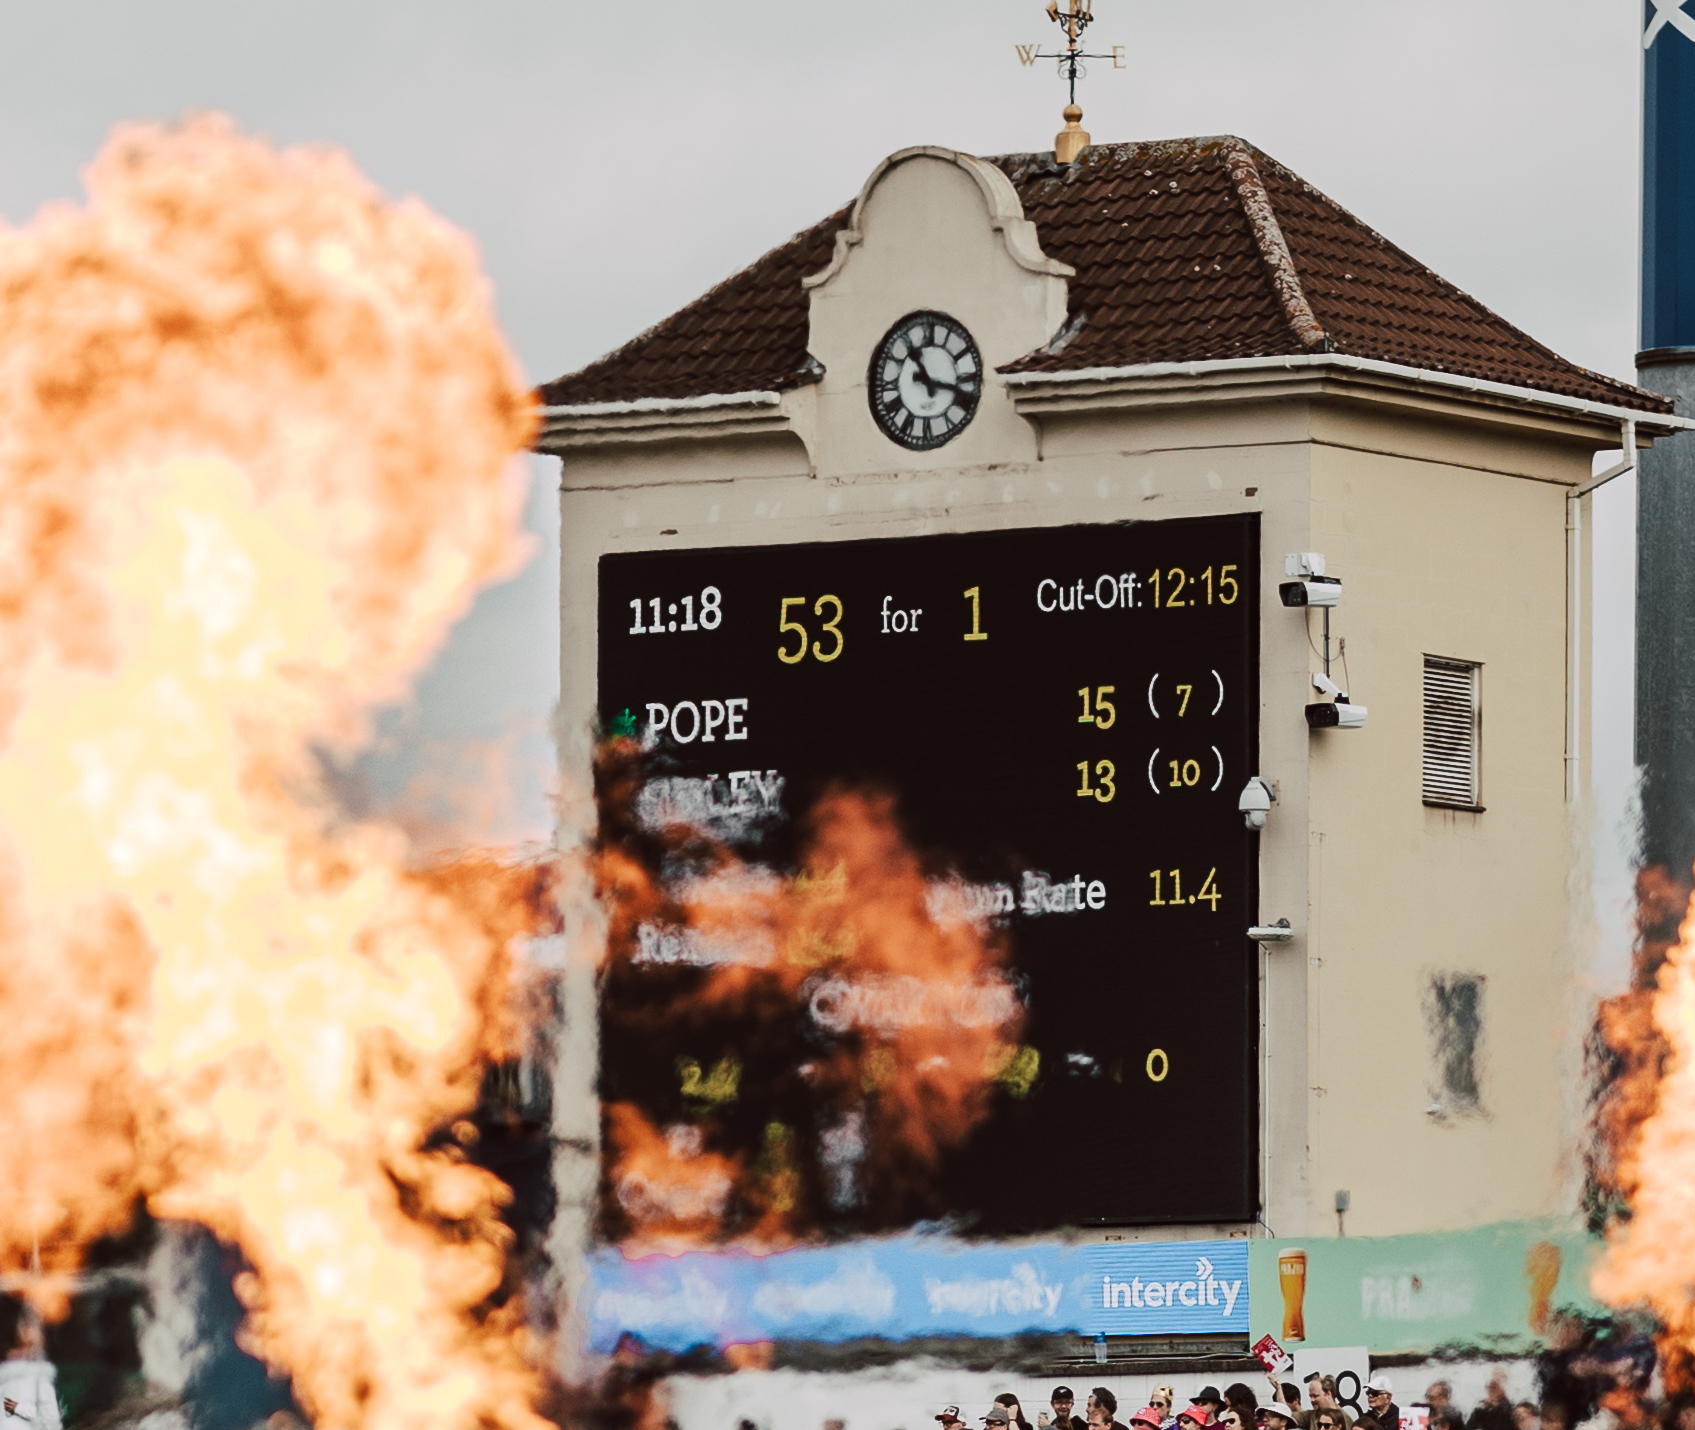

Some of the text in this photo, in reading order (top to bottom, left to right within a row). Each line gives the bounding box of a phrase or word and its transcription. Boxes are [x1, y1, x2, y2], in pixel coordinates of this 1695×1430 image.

[1037, 565, 1238, 612] Cut-Off: 12:15
[630, 587, 722, 635] 11:18
[778, 587, 988, 664] 53 for 1
[645, 698, 748, 750] POPE
[1078, 686, 1116, 729] 15
[1077, 760, 1116, 803] 13
[1149, 867, 1222, 911] 11.4
[1146, 1048, 1169, 1082] 0
[1103, 1276, 1242, 1316] intercity
